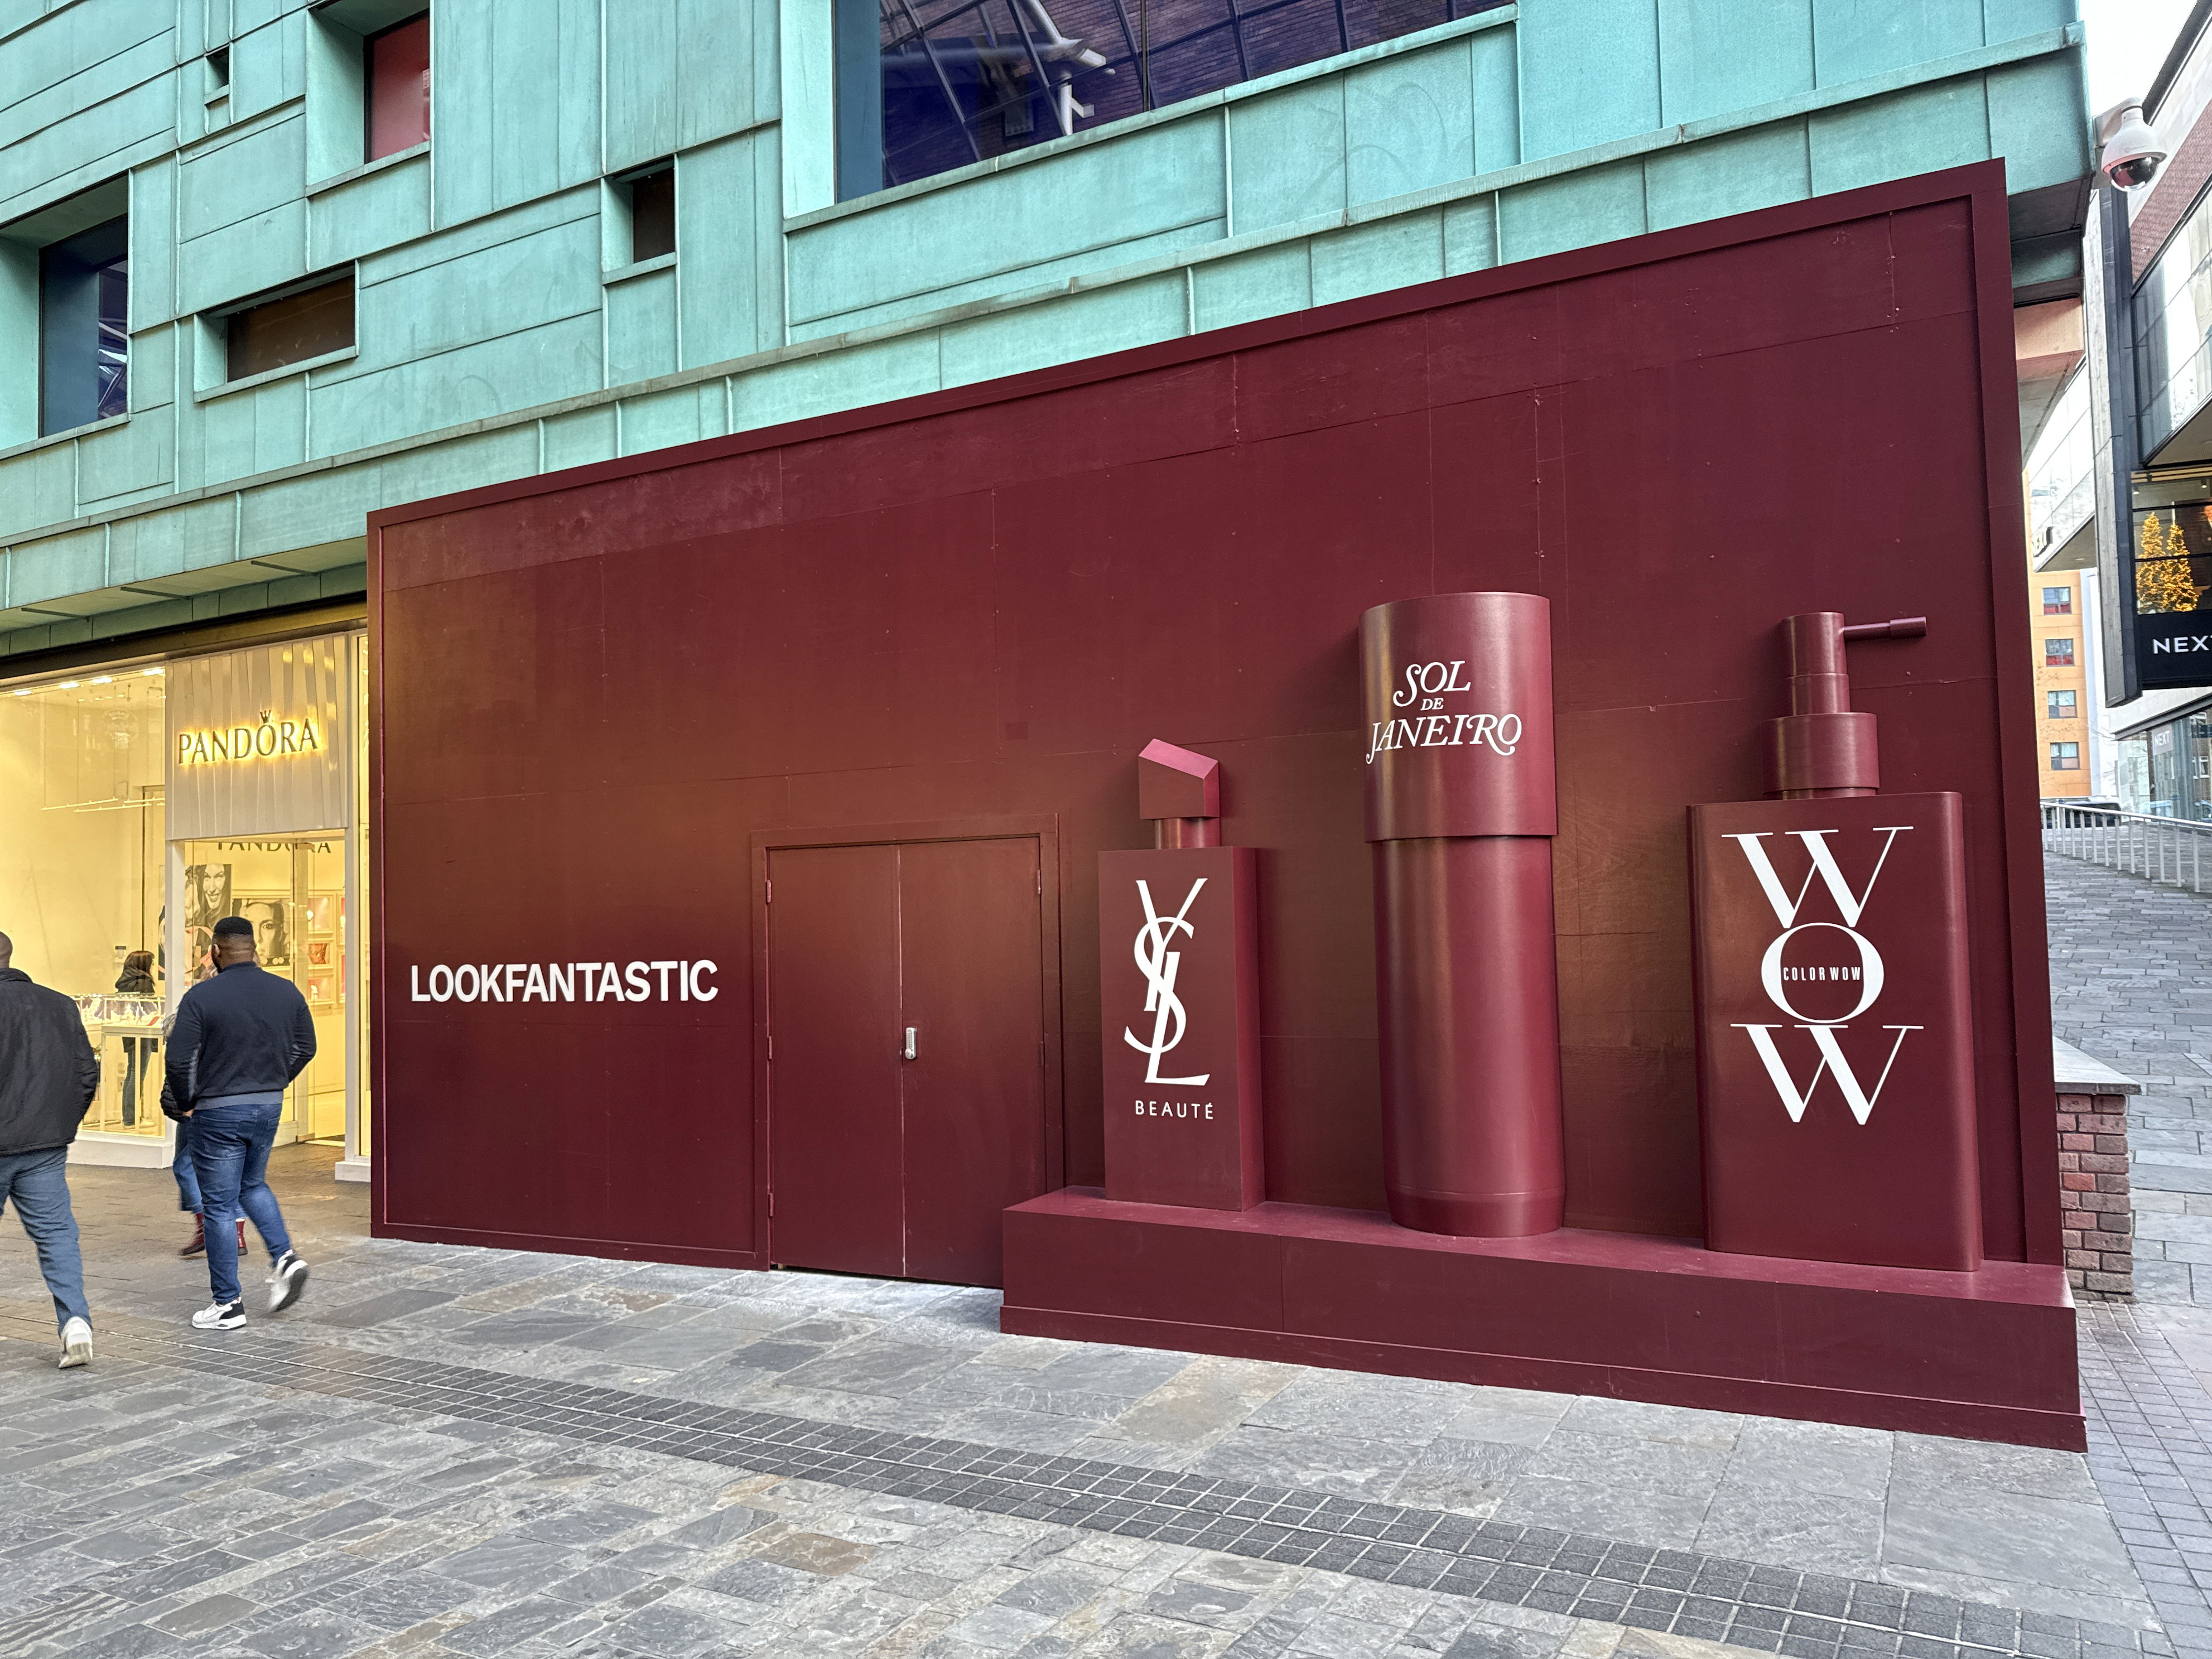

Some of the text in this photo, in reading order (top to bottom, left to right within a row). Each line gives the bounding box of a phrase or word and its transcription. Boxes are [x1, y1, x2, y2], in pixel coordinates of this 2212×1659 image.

[2152, 635, 2212, 654] NEX
[1392, 660, 1472, 707] SOL
[1420, 697, 1444, 711] DE
[179, 718, 319, 764] PANDORA
[1366, 713, 1522, 765] JANEIRO
[2155, 730, 2170, 748] NEXT
[411, 959, 719, 1003] LOOKFANTASTIC
[1124, 877, 1211, 1086] YSL
[1135, 1100, 1213, 1120] BEAUTÉ
